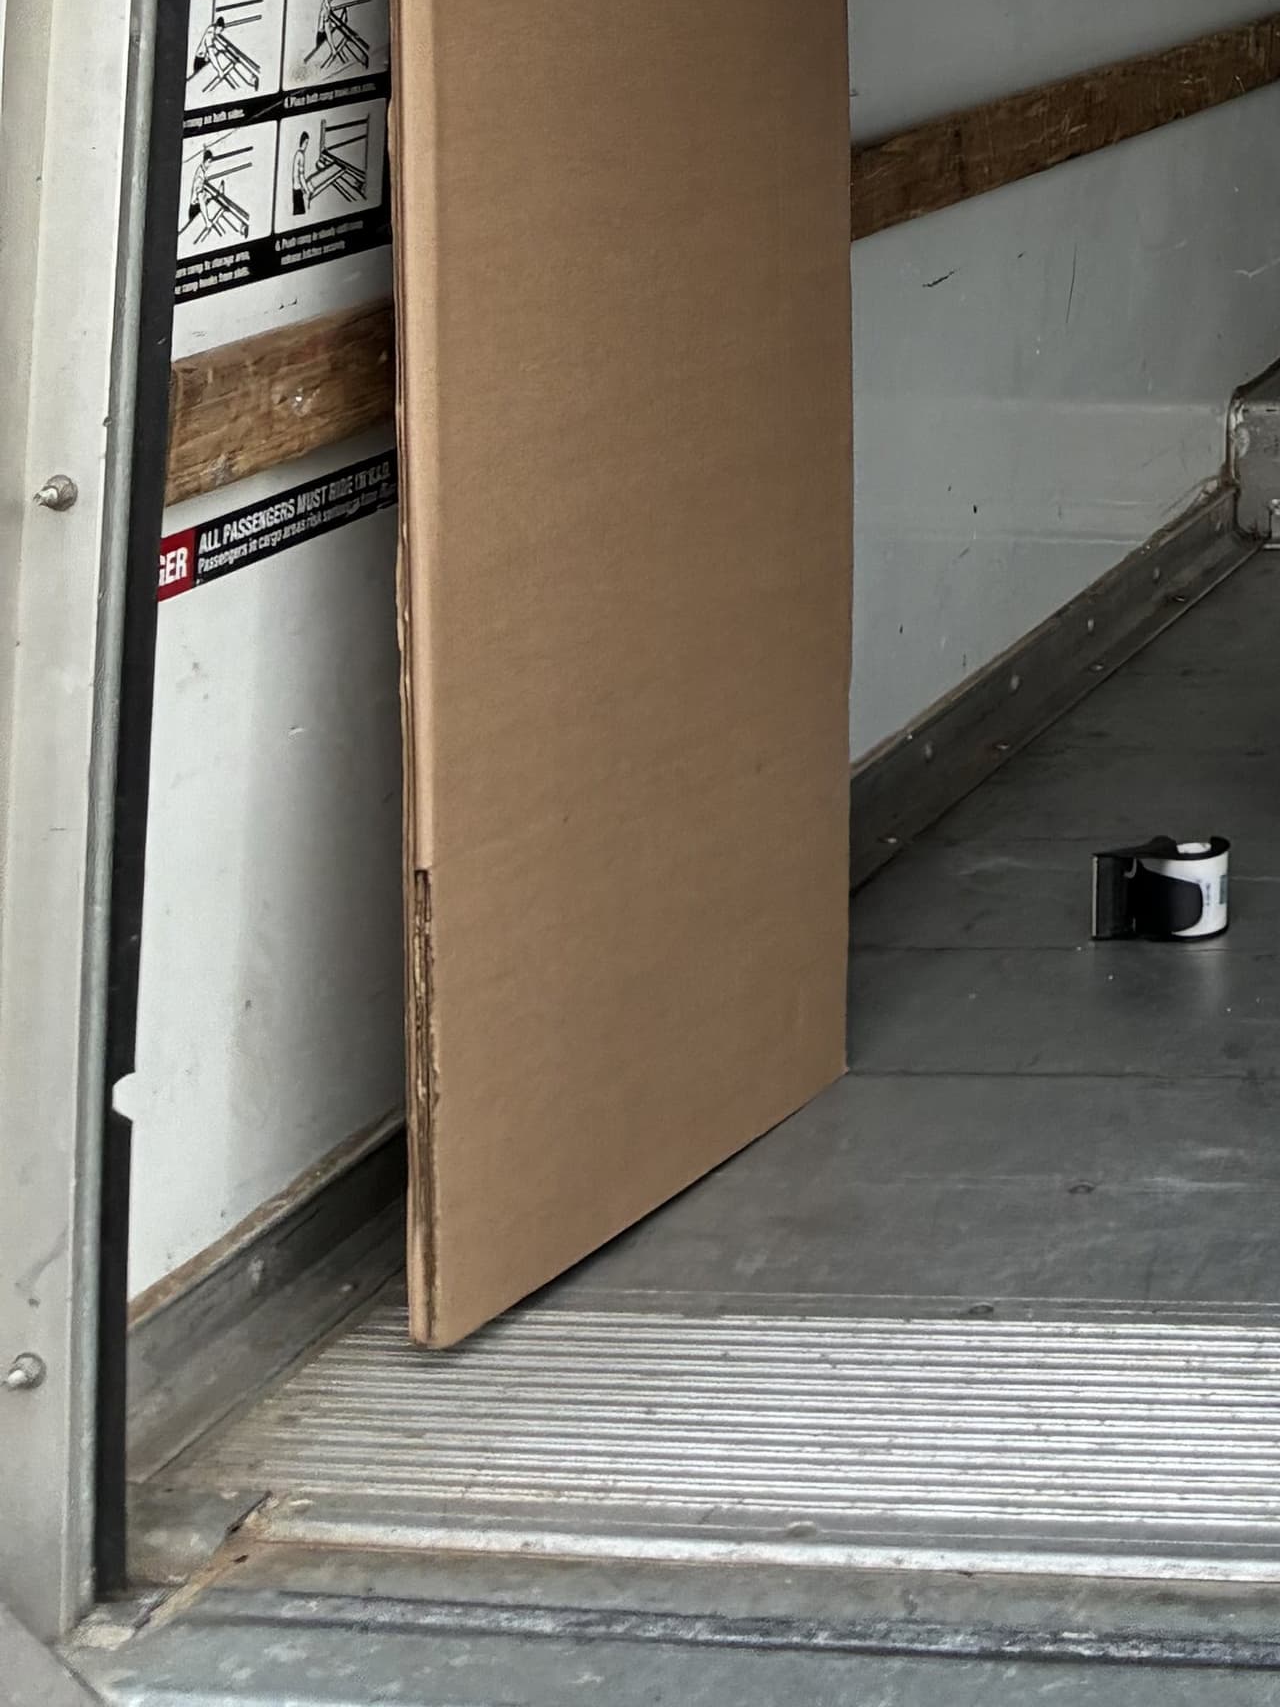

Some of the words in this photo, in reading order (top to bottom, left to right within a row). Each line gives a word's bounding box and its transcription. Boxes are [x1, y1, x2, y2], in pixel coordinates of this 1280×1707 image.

[199, 528, 221, 555] ALL
[223, 498, 295, 545] PASSENGERS
[297, 486, 328, 514] MUST
[198, 541, 248, 574] Passengers
[250, 538, 257, 552] in
[258, 531, 282, 550] cargo
